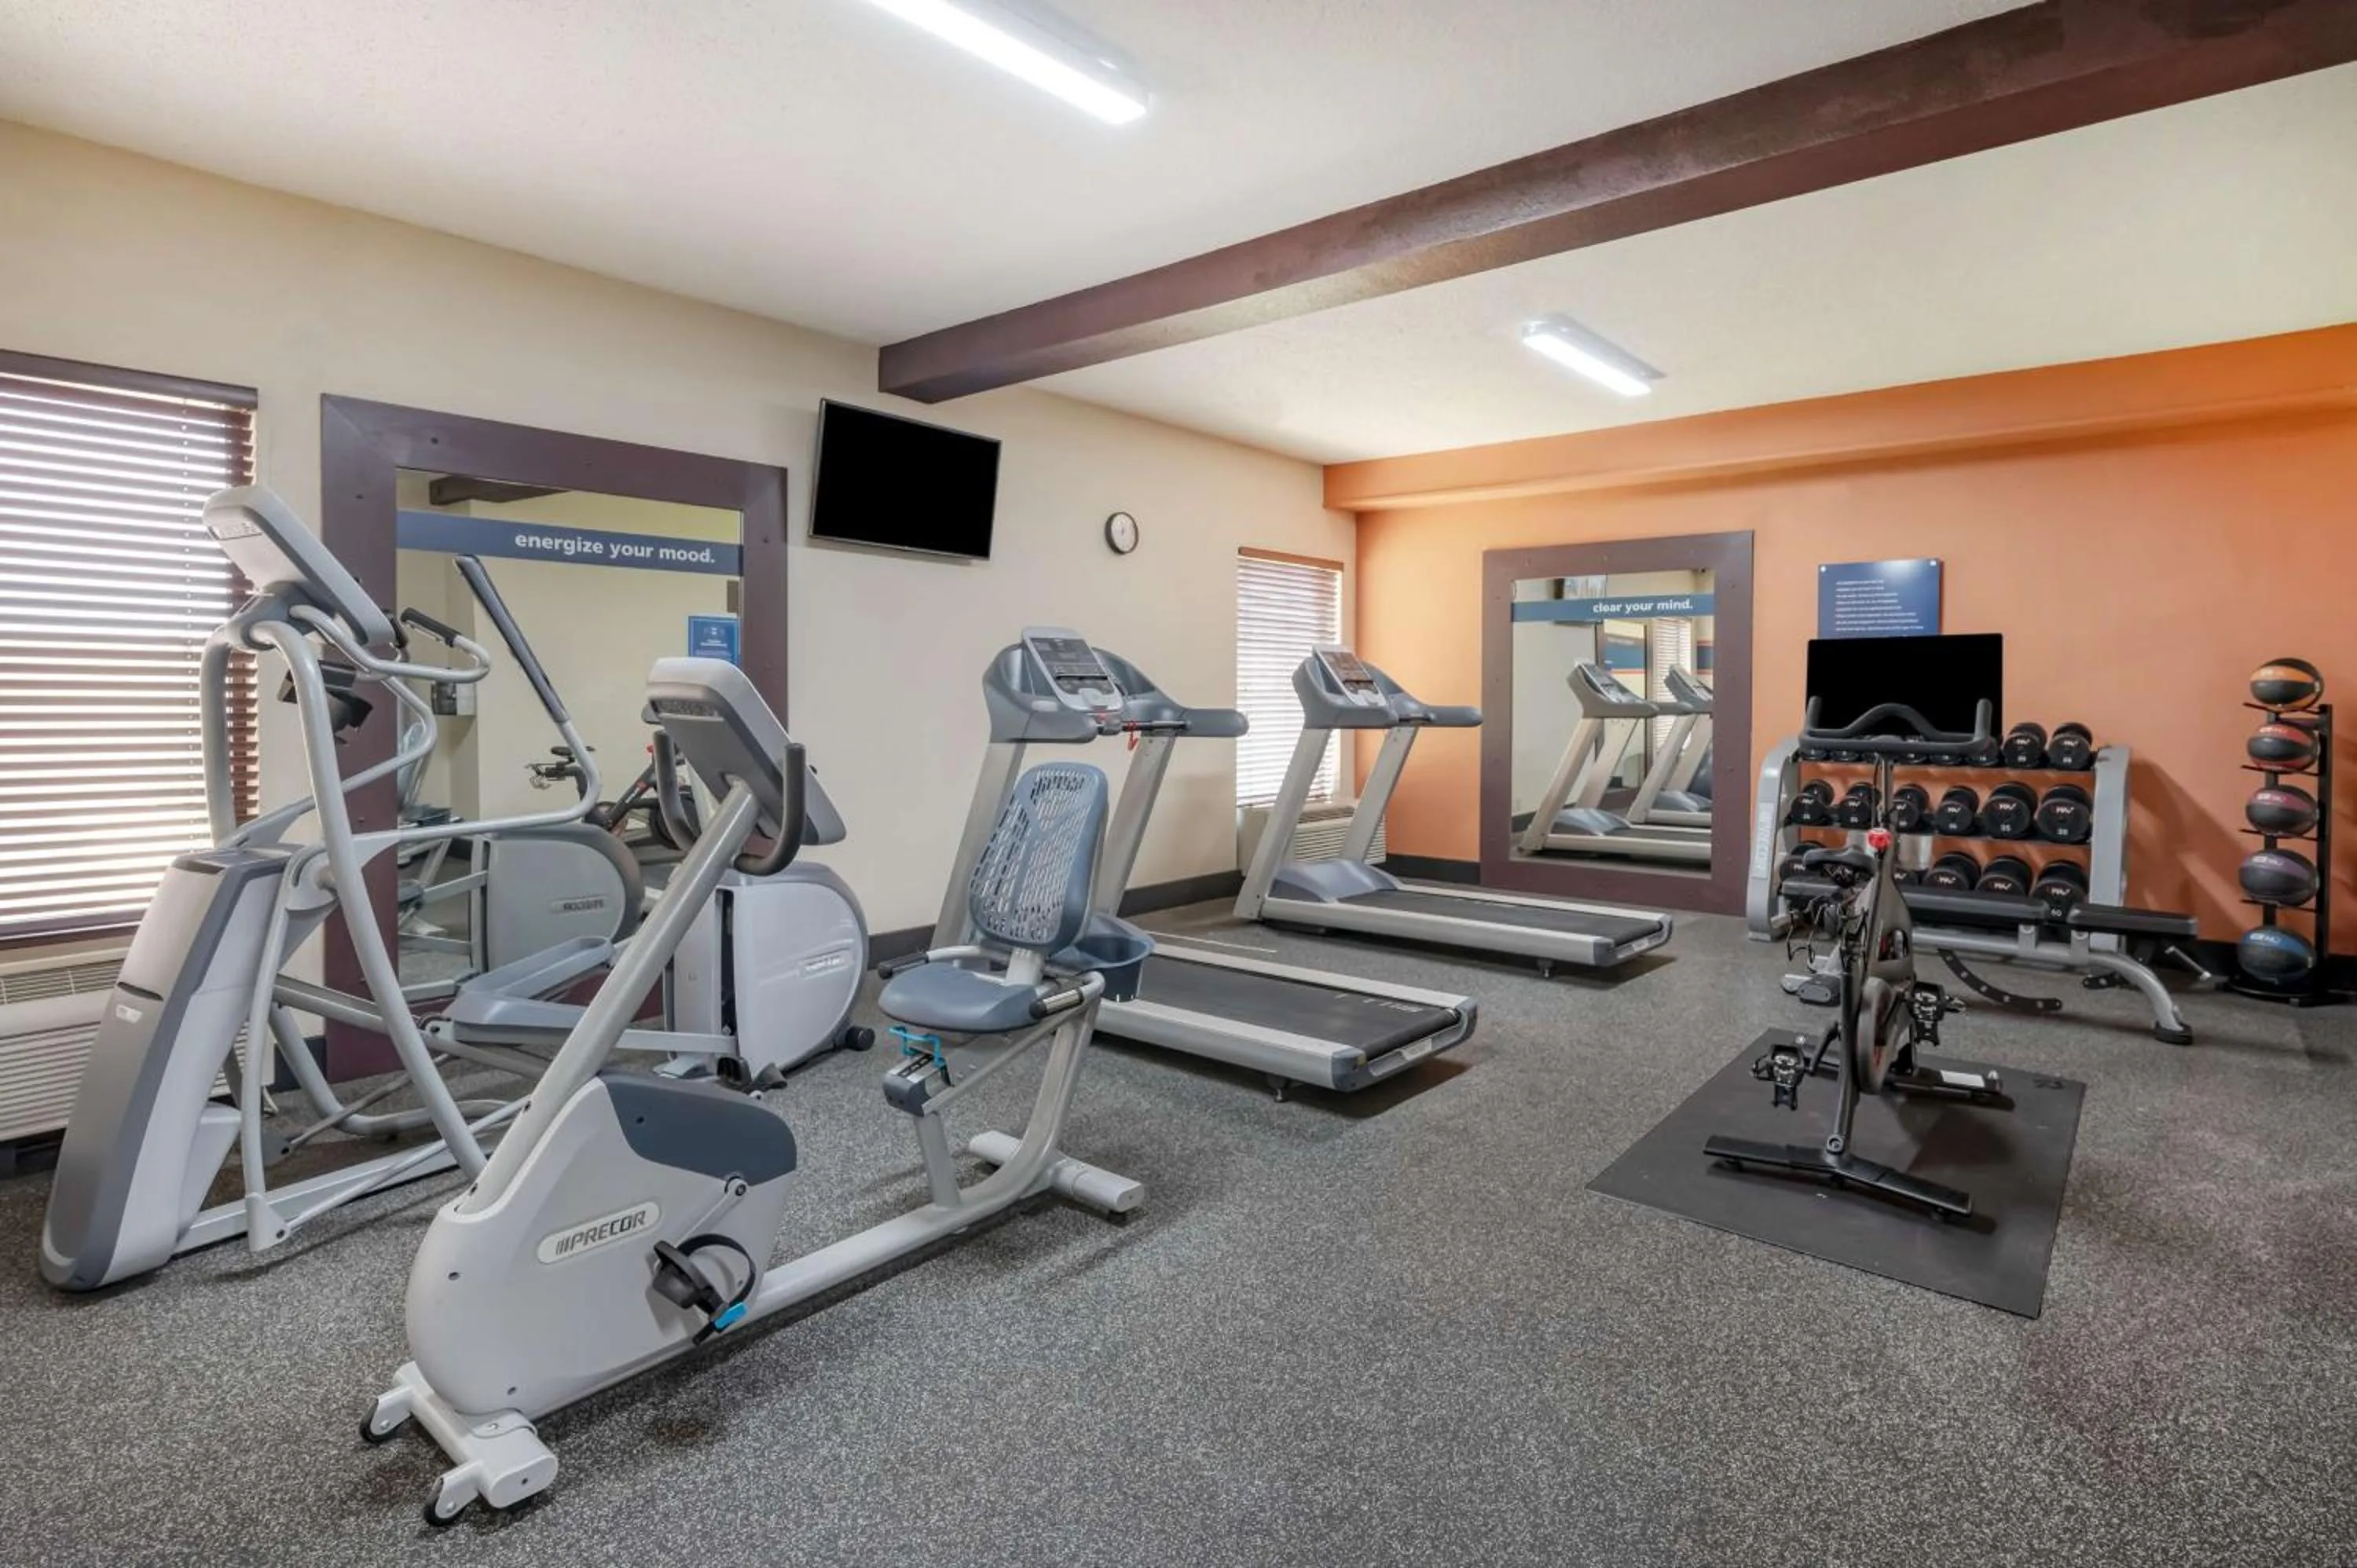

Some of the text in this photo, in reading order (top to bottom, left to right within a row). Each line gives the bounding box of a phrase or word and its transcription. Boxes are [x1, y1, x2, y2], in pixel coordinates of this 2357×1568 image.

[515, 534, 716, 563] energize your mood.
[1593, 599, 1693, 613] clear your mind.
[569, 1211, 646, 1251] PRECOR
